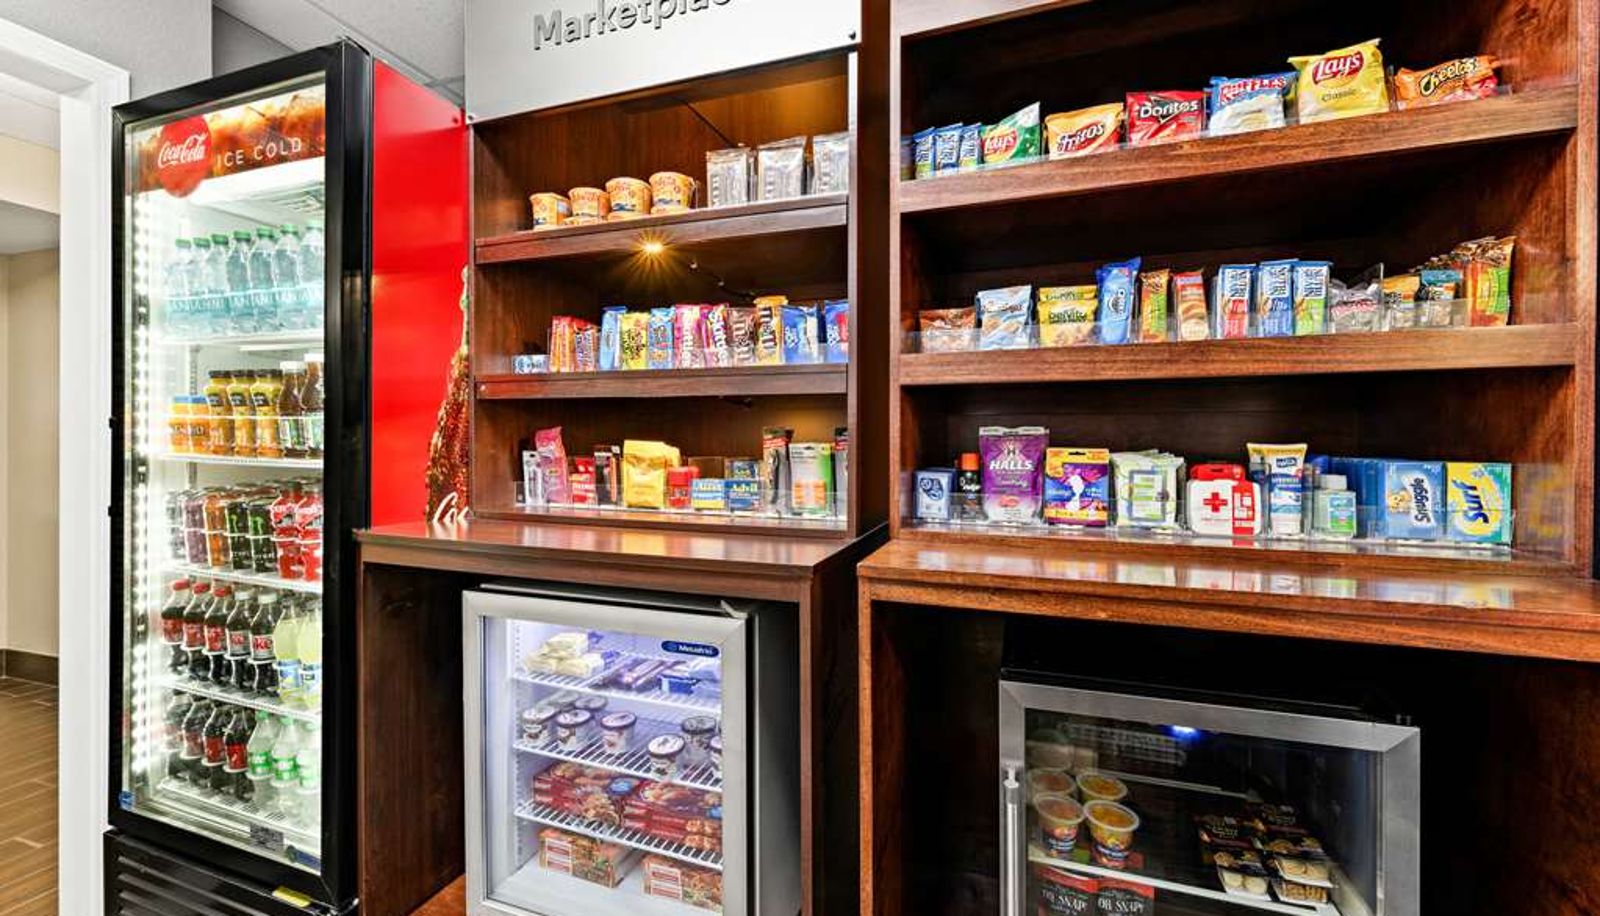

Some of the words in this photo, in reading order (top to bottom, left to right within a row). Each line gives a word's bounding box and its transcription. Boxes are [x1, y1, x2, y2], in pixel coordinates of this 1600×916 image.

[1419, 57, 1479, 97] Cheetos
[1140, 100, 1198, 118] Doritos
[216, 145, 245, 168] ICE
[254, 137, 303, 161] COLD
[1058, 122, 1105, 153] Fritos
[989, 460, 1034, 471] HALLS
[1409, 477, 1431, 524] Snuggle
[1451, 479, 1490, 524] Surf
